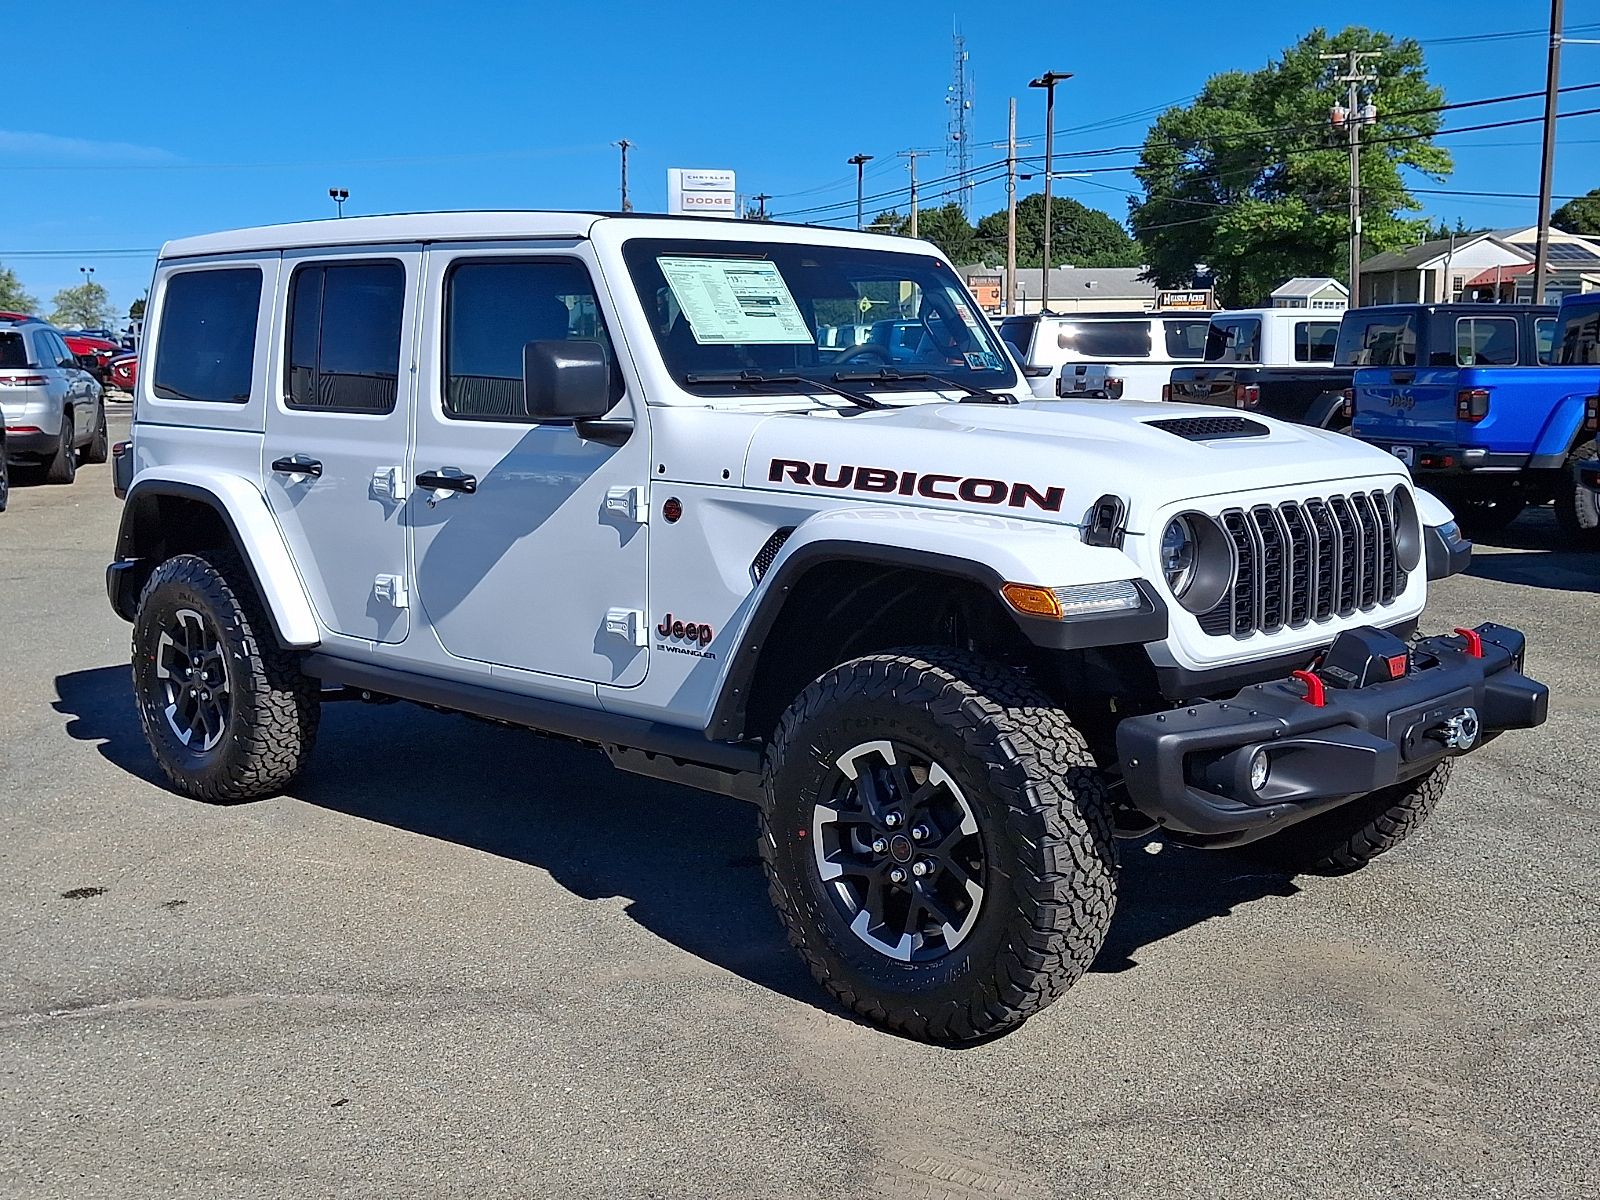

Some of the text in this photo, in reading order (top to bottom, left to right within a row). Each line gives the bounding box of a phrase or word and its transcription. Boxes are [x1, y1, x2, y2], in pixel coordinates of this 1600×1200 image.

[686, 197, 731, 205] DODGE
[1388, 391, 1416, 411] Jeep
[768, 458, 1066, 513] RUBICON
[657, 612, 713, 647] Jeep
[665, 645, 717, 660] WRANGLER
